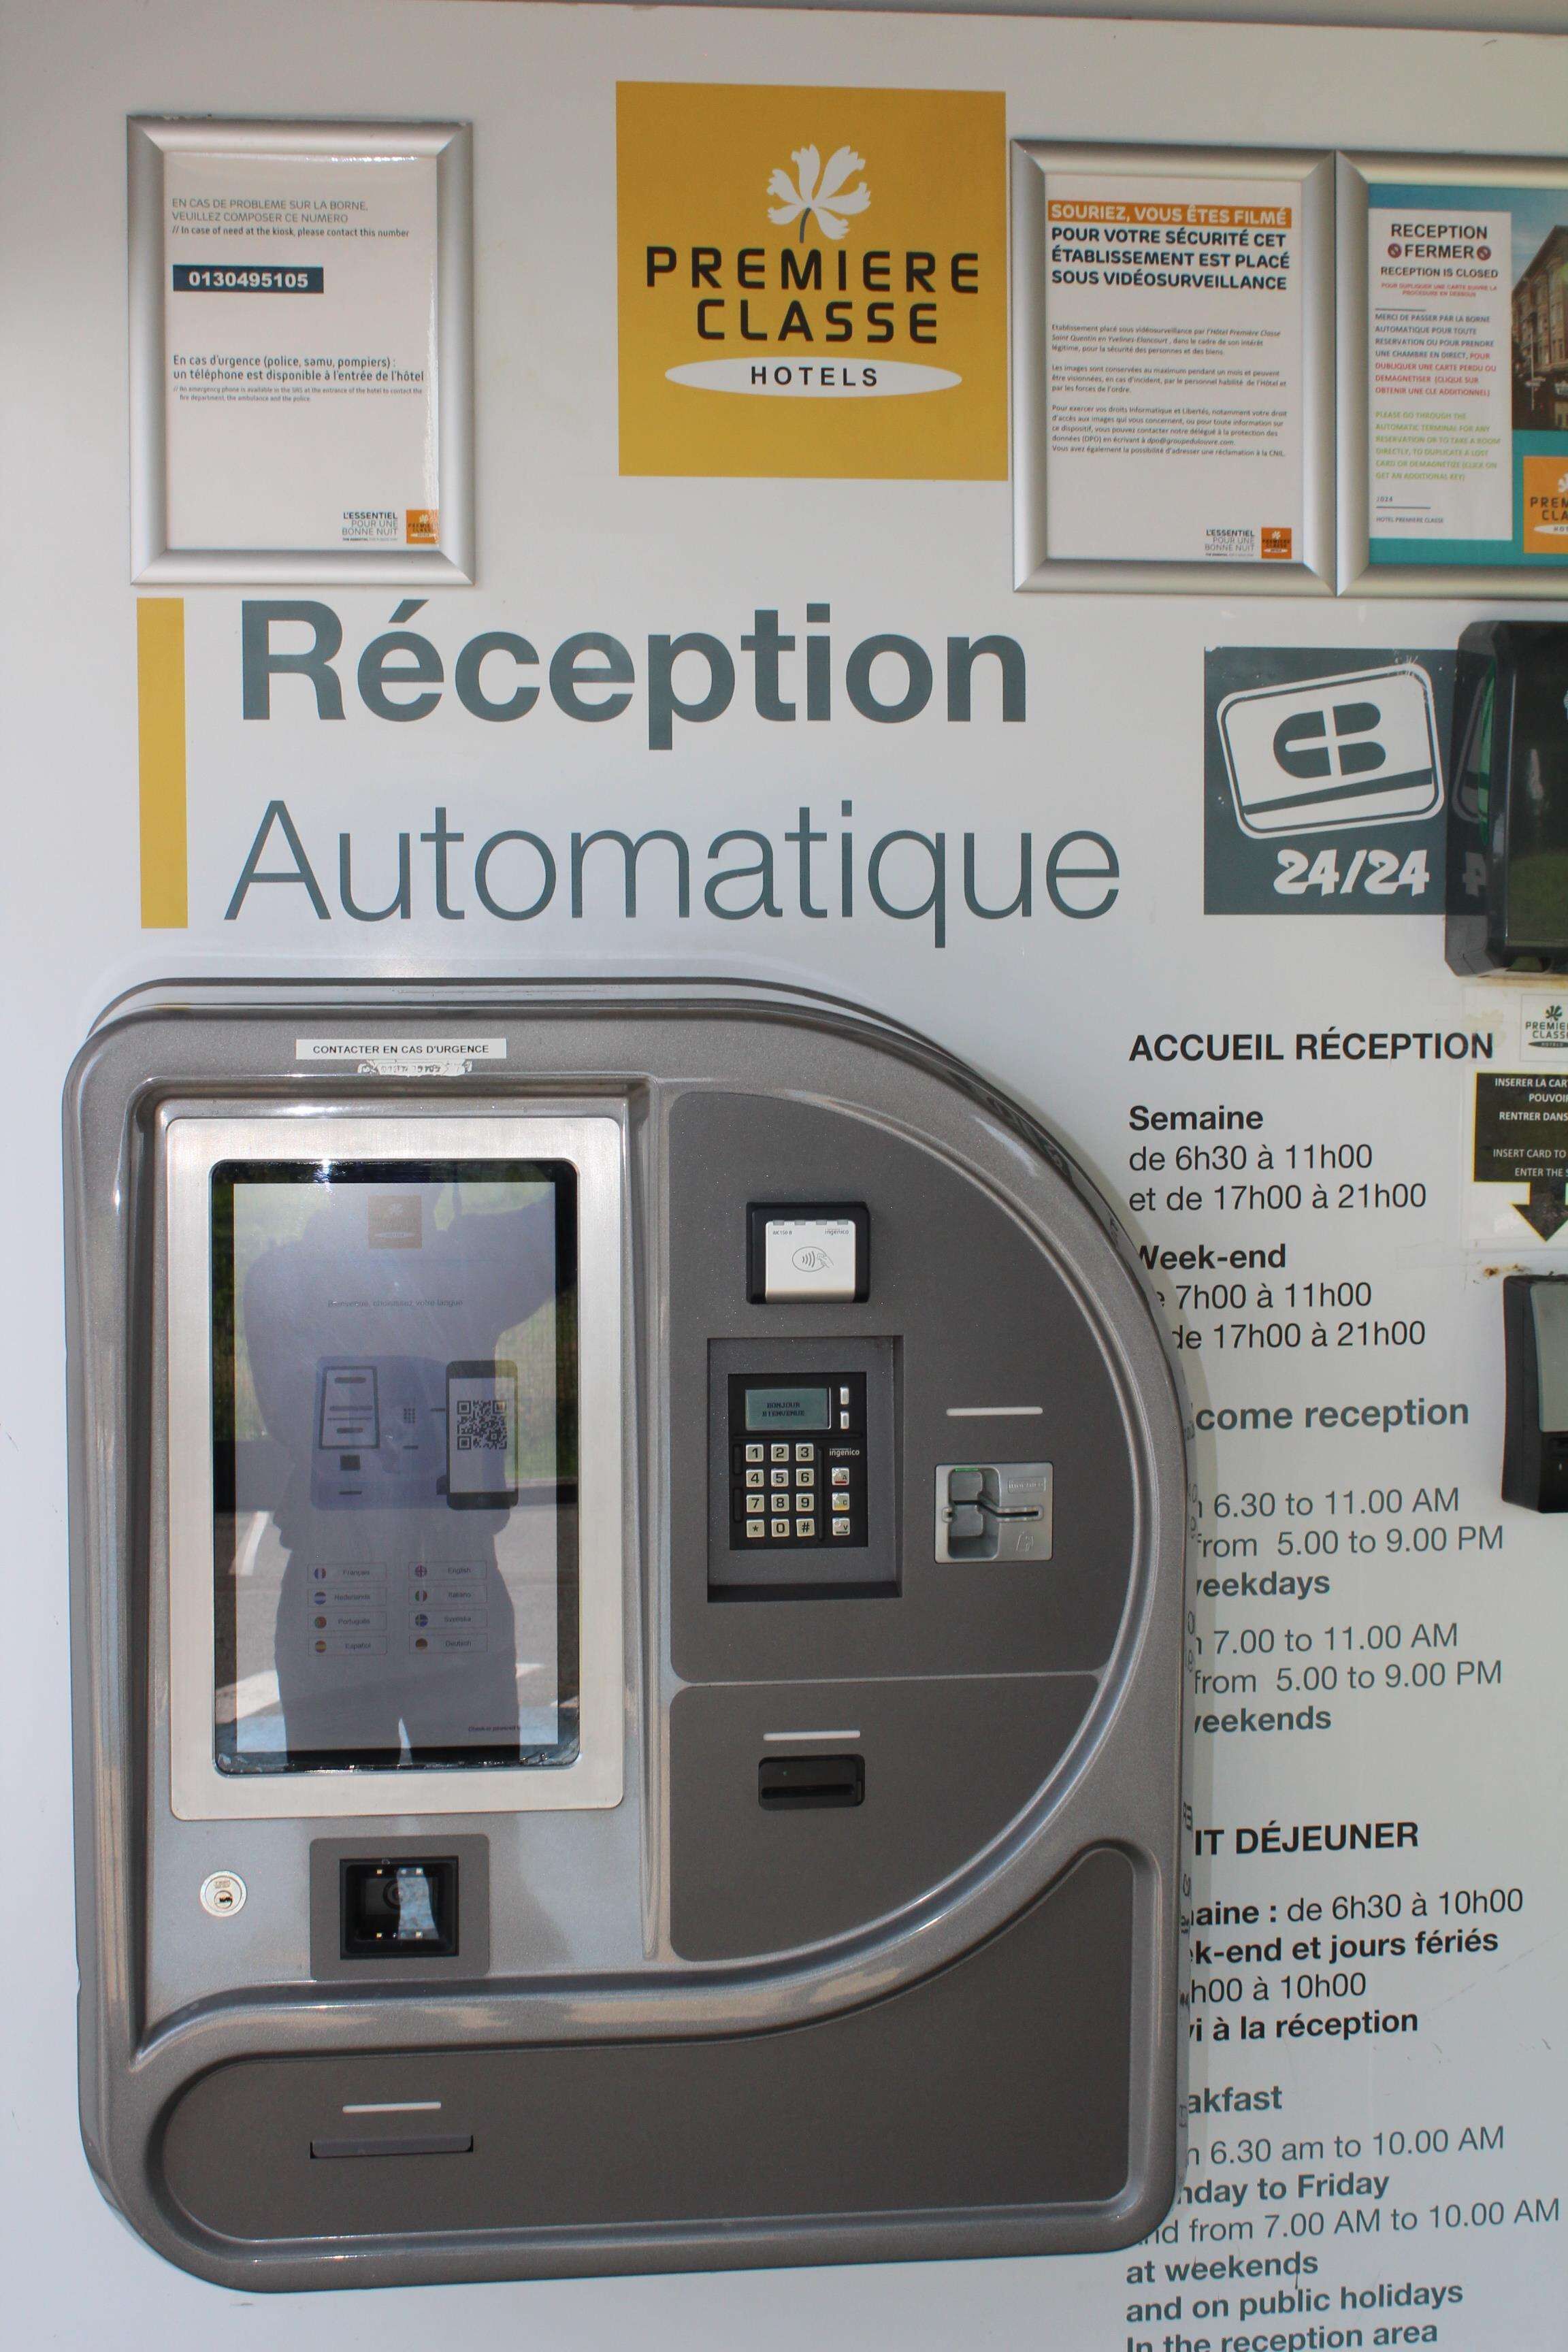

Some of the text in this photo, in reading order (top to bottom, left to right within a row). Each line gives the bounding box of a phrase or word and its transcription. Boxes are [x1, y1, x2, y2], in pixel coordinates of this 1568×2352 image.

[172, 198, 187, 208] EN
[189, 198, 210, 208] CAS
[212, 199, 227, 209] DE
[229, 199, 286, 210] PROBLEME
[289, 200, 311, 210] SUR
[314, 201, 327, 210] LA
[172, 211, 348, 224] VEUILLEZ COMPOSER CE NUMERO
[1051, 204, 1286, 225] SOURIEZ, VOUS ÊTES FILMÉ
[181, 226, 186, 234] In
[212, 225, 221, 235] of
[223, 226, 244, 235] need
[245, 227, 255, 235] at
[257, 226, 270, 235] the
[297, 227, 325, 238] please
[327, 228, 358, 237] contact
[359, 228, 376, 237] this
[378, 228, 409, 238] number
[1051, 227, 1286, 248] POUR VOTRE SÉCURITÉ CET
[1391, 223, 1488, 240] RECEPTION
[1051, 244, 1290, 270] ÉTABLISSEMENT EST PLACÉ
[1405, 244, 1474, 259] FERMER
[189, 271, 308, 289] 0130495105
[647, 246, 979, 294] PREMIERE
[1051, 268, 1287, 291] SOUS VIDÉOSURVEILLANCE
[1380, 266, 1499, 278] RECEPTION IS CLOSED
[697, 298, 937, 344] CLASSE
[174, 355, 391, 370] En cas d'urgence (police, samu, pompiers)
[174, 368, 424, 383] un téléphone est disponible à l'entrée de l'hôtel
[751, 365, 877, 387] HOTELS
[242, 599, 1026, 751] Réception
[224, 800, 1120, 949] Automatique
[1273, 849, 1430, 897] 24/24
[312, 1045, 488, 1054] CONTACTER EN CAS D'URGENCE
[1128, 1026, 1493, 1062] ACCUEIL RÉCEPTION
[1494, 1078, 1533, 1087] INSERER
[1535, 1079, 1546, 1087] LA
[1129, 1105, 1264, 1131] Semaine
[1499, 1112, 1540, 1121] RENTRER
[1129, 1143, 1373, 1171] de 6h30 à 11h00
[1493, 1149, 1566, 1158] INSERT CARD TO
[1515, 1168, 1544, 1176] ENTER
[1546, 1169, 1563, 1177] THE
[1129, 1183, 1426, 1212] et de 17h00 à 21h00
[1175, 1284, 1247, 1310] 7h00
[1256, 1283, 1274, 1309] à
[1285, 1281, 1371, 1307] 11h00
[1213, 1322, 1301, 1349] 17h00
[1311, 1322, 1328, 1348] à
[1337, 1320, 1426, 1346] 21h00
[1195, 1397, 1469, 1433] come reception
[830, 1448, 860, 1457] ingenico
[1213, 1492, 1275, 1518] 6.30
[1285, 1492, 1313, 1516] to
[1325, 1488, 1403, 1515] 11.00
[1411, 1487, 1458, 1513] AM
[1277, 1530, 1339, 1556] 5.00
[1348, 1531, 1376, 1554] to
[1386, 1527, 1447, 1553] 9.00
[1458, 1525, 1503, 1550] PM
[1196, 1571, 1330, 1600] eekdays
[1236, 1820, 1418, 1855] DÉJEUNER
[1192, 1888, 1523, 1927] aine de 6h30 à 10h00
[1190, 1928, 1499, 1965] k-end et jours fériés
[1213, 2016, 1230, 2042] à
[1241, 2015, 1265, 2040] la
[1276, 2009, 1418, 2041] réception
[1188, 2085, 1283, 2114] akfast
[1210, 2138, 1271, 2165] 6.30
[1281, 2141, 1324, 2161] am
[1333, 2136, 1361, 2158] to
[1373, 2129, 1449, 2156] 10.00
[1458, 2125, 1503, 2151] AM
[1177, 2171, 1390, 2206] nday to Friday
[1188, 2218, 1253, 2242] from
[1264, 2212, 1324, 2238] 7.00
[1334, 2208, 1380, 2234] AM
[1390, 2208, 1418, 2231] to
[1429, 2202, 1505, 2228] 10.00
[1514, 2198, 1559, 2224] AM
[1126, 2251, 1319, 2285] at weekends
[1126, 2282, 1463, 2323] and on public holidays
[1221, 2325, 1362, 2352] reception
[1373, 2324, 1437, 2346] area
